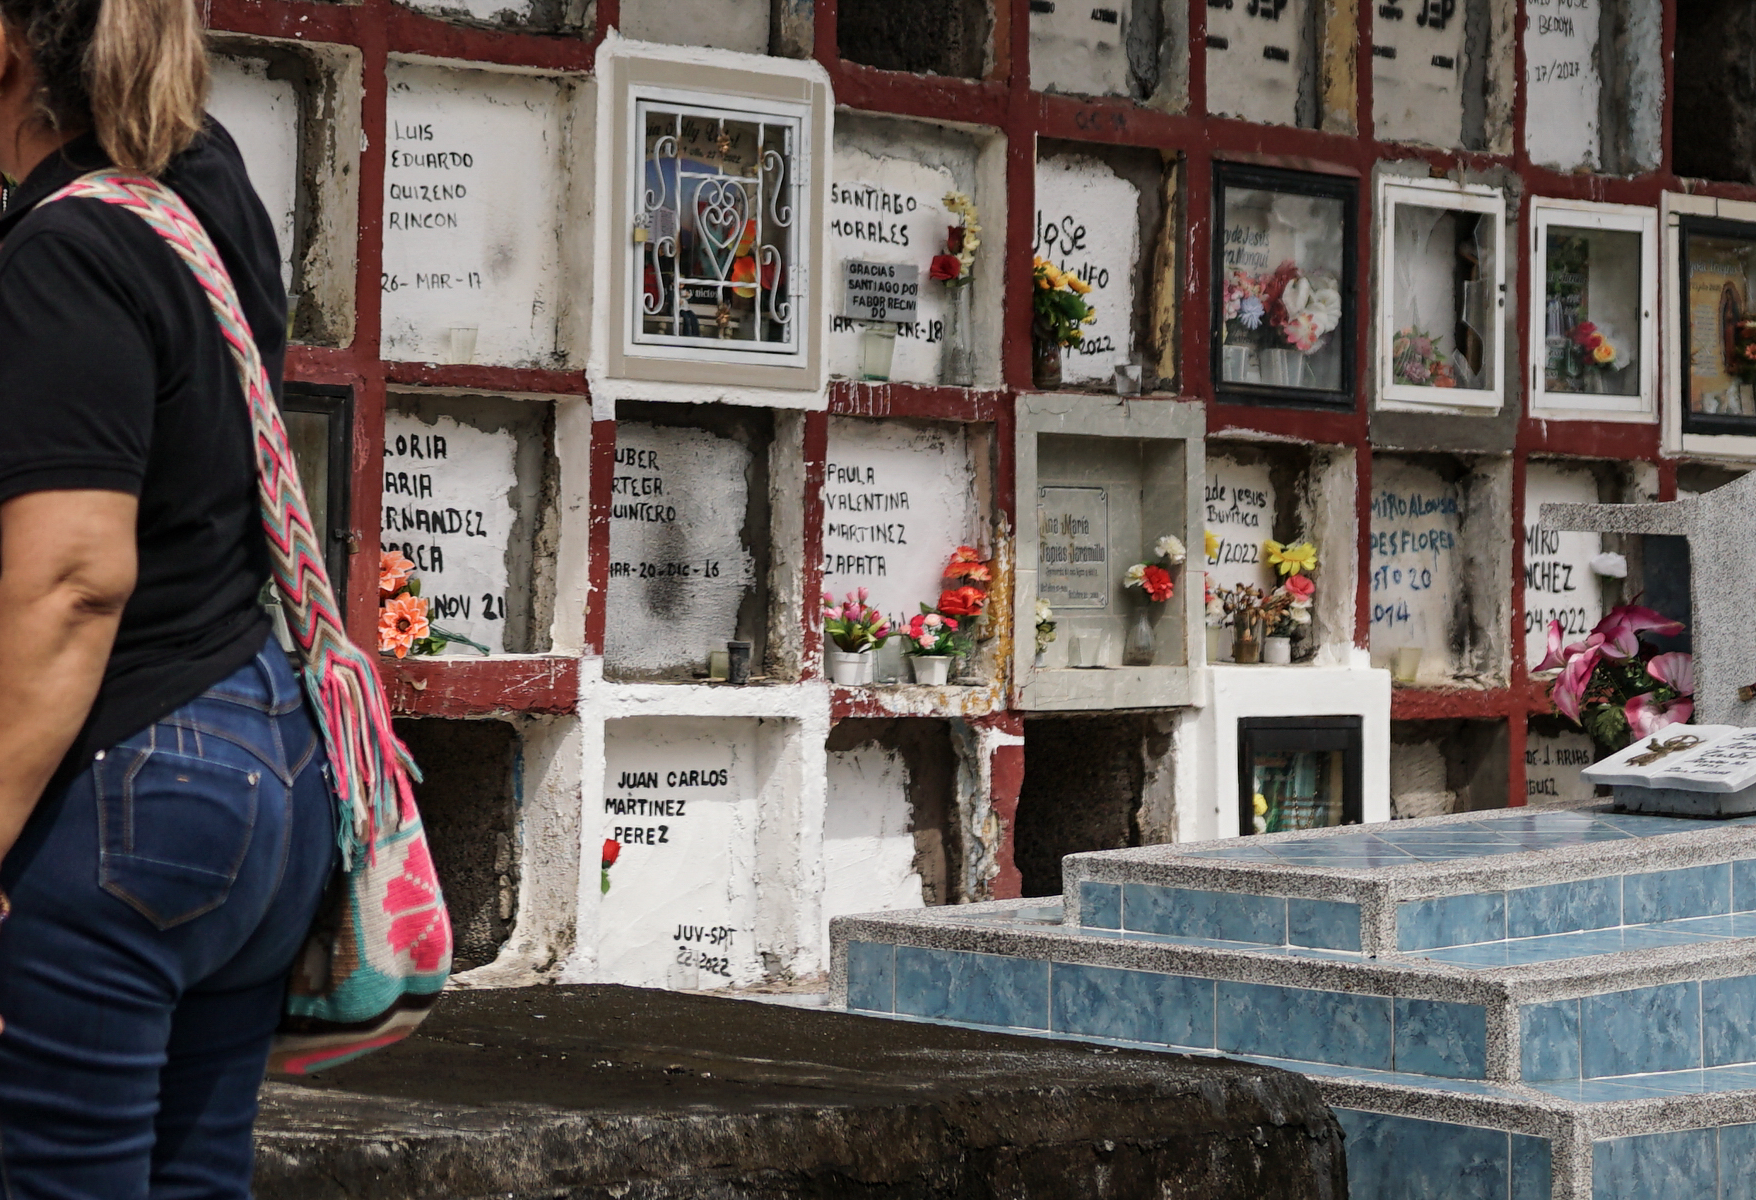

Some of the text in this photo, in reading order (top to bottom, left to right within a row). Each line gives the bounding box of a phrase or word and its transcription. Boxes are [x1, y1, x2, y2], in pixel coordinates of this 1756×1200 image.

[395, 119, 434, 141] LUIS
[391, 150, 474, 170] EDUARDO
[830, 182, 918, 215] SANTIAGO
[389, 211, 459, 231] RINCON
[830, 219, 910, 247] MORALES
[849, 262, 896, 278] GRACIAS
[848, 279, 900, 293] SANTIAGO
[827, 463, 875, 486] PAULA
[826, 491, 911, 512] VALENTINA
[828, 522, 908, 545] MARTINEZ
[824, 553, 887, 577] ZAPATA
[618, 768, 729, 789] JUAN CARLOS
[604, 798, 686, 817] MARTINEZ
[614, 825, 669, 845] PEREZ
